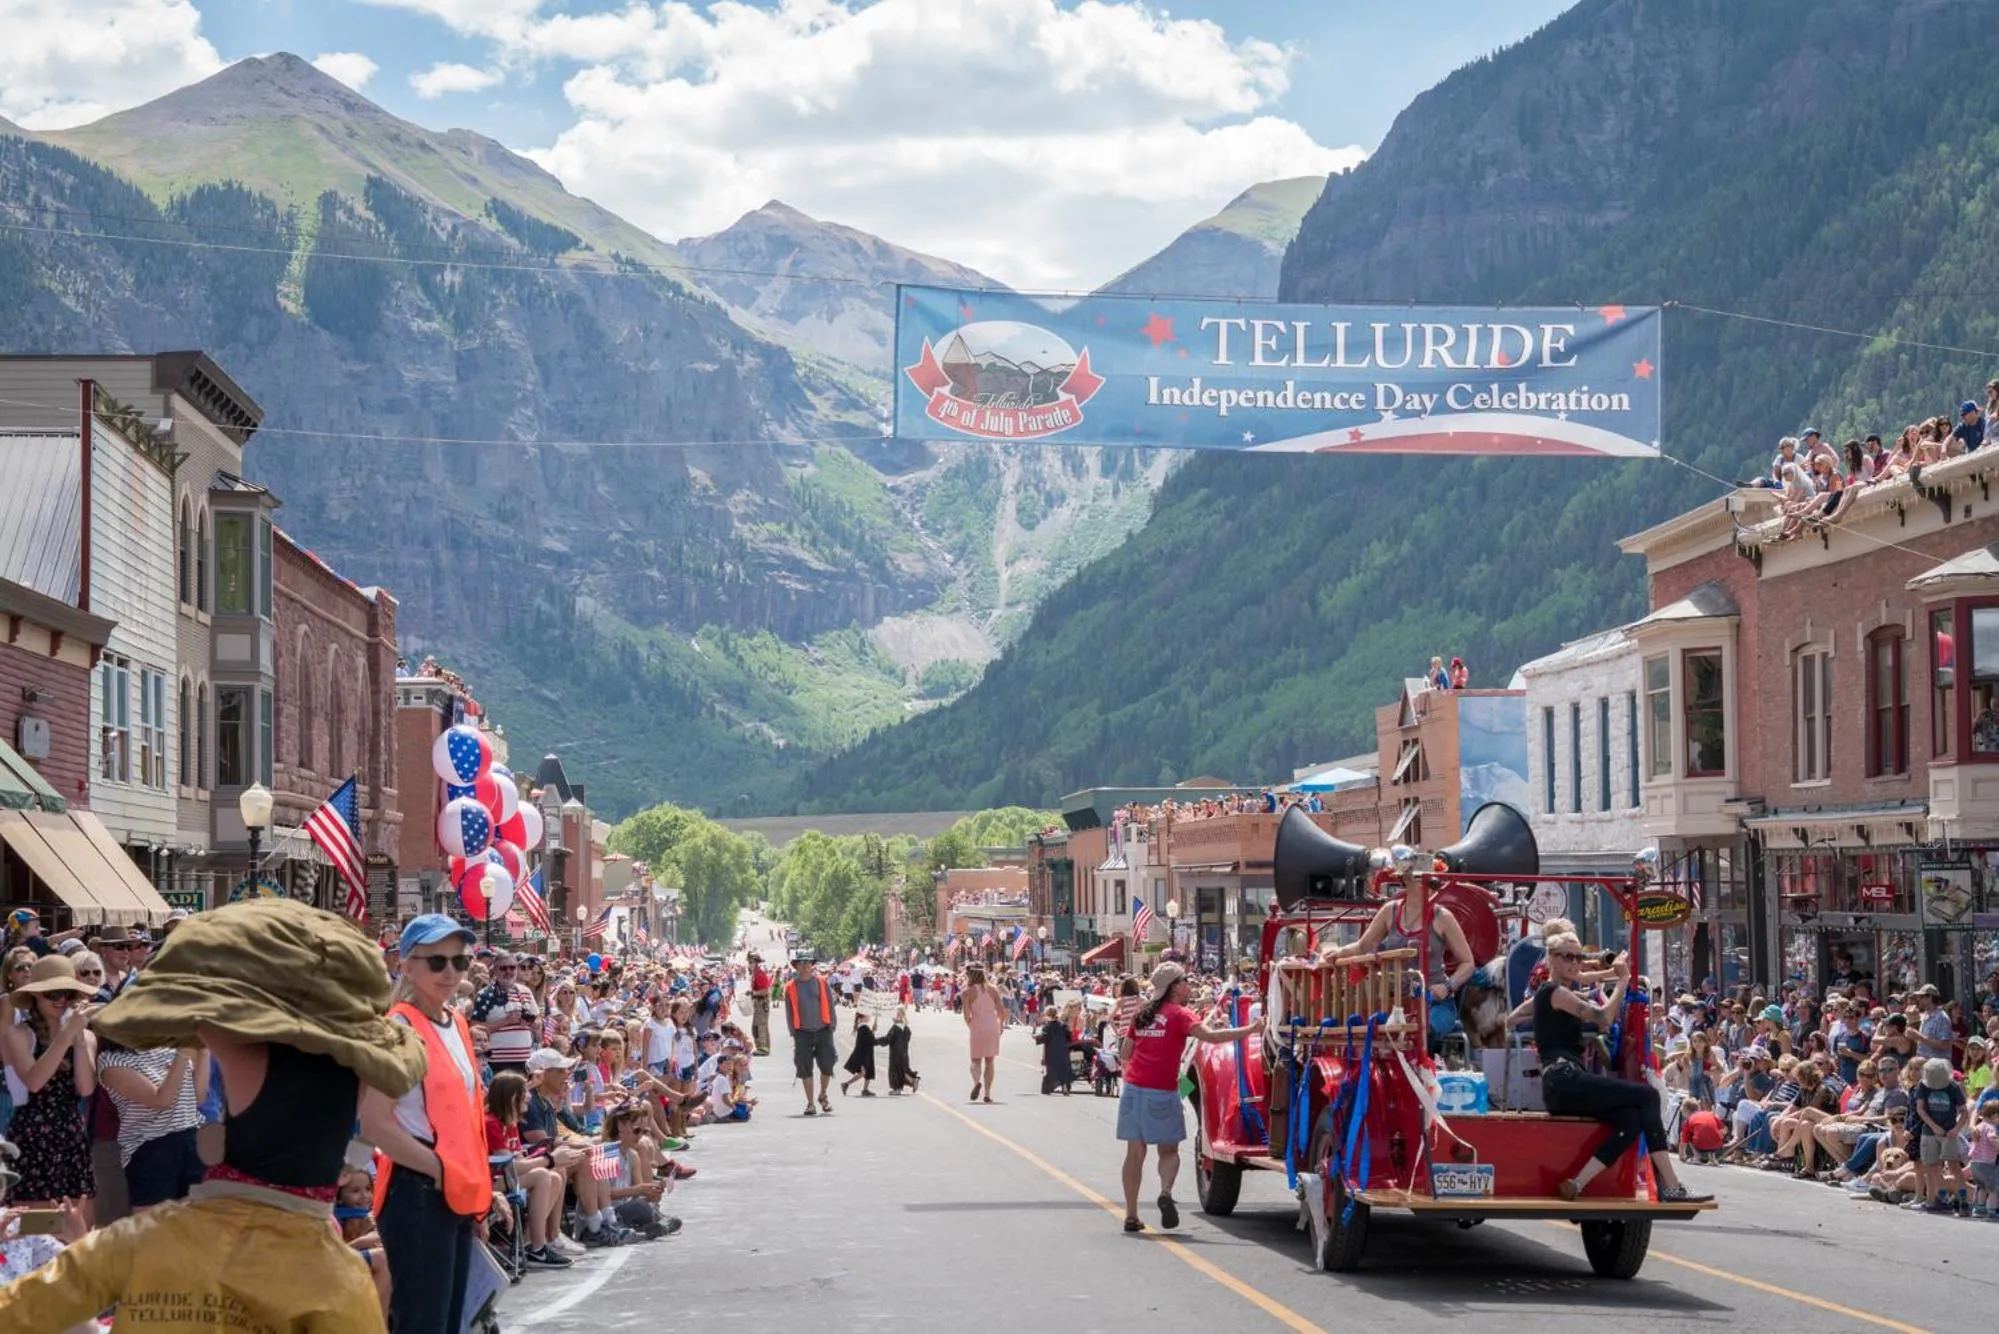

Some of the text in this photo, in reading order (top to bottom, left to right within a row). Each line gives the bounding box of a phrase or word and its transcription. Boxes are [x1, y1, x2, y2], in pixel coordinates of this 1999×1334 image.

[1200, 317, 1578, 370] TELLURIDE
[938, 400, 1073, 436] 4th of July Parade
[1147, 376, 1631, 419] Independence Day Celebration
